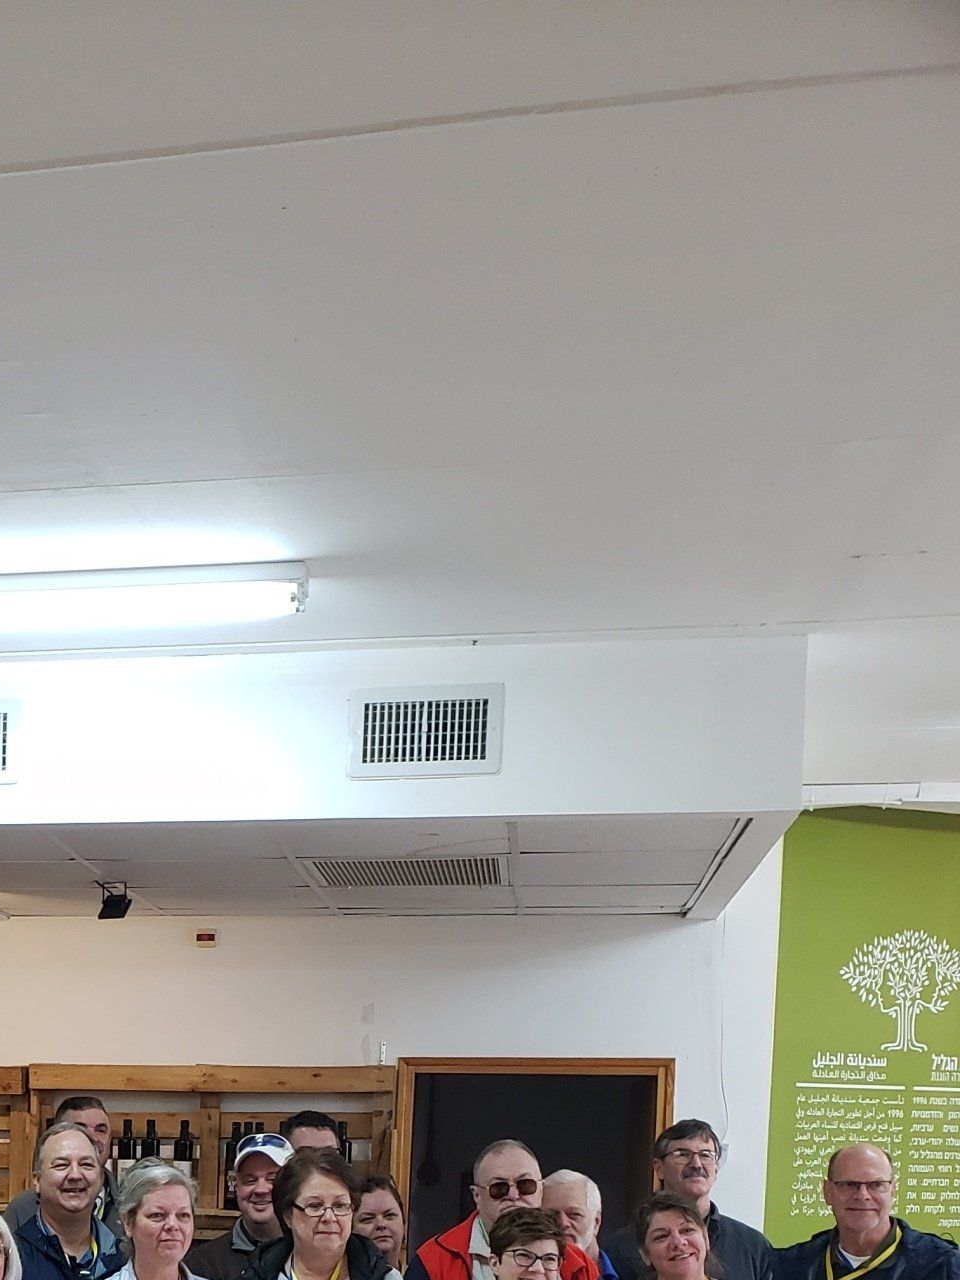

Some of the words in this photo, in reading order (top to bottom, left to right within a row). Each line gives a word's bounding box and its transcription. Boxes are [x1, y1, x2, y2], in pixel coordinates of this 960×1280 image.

[812, 1051, 844, 1068] الجليل
[846, 1052, 887, 1069] سنديانة
[932, 1053, 958, 1071] הגליל
[812, 1069, 839, 1079] العادلة
[841, 1069, 865, 1081] التجارة
[866, 1071, 887, 1082] مذاق
[808, 1093, 830, 1105] الجليل
[832, 1093, 856, 1105] سنديانة
[888, 1109, 904, 1118] 1996
